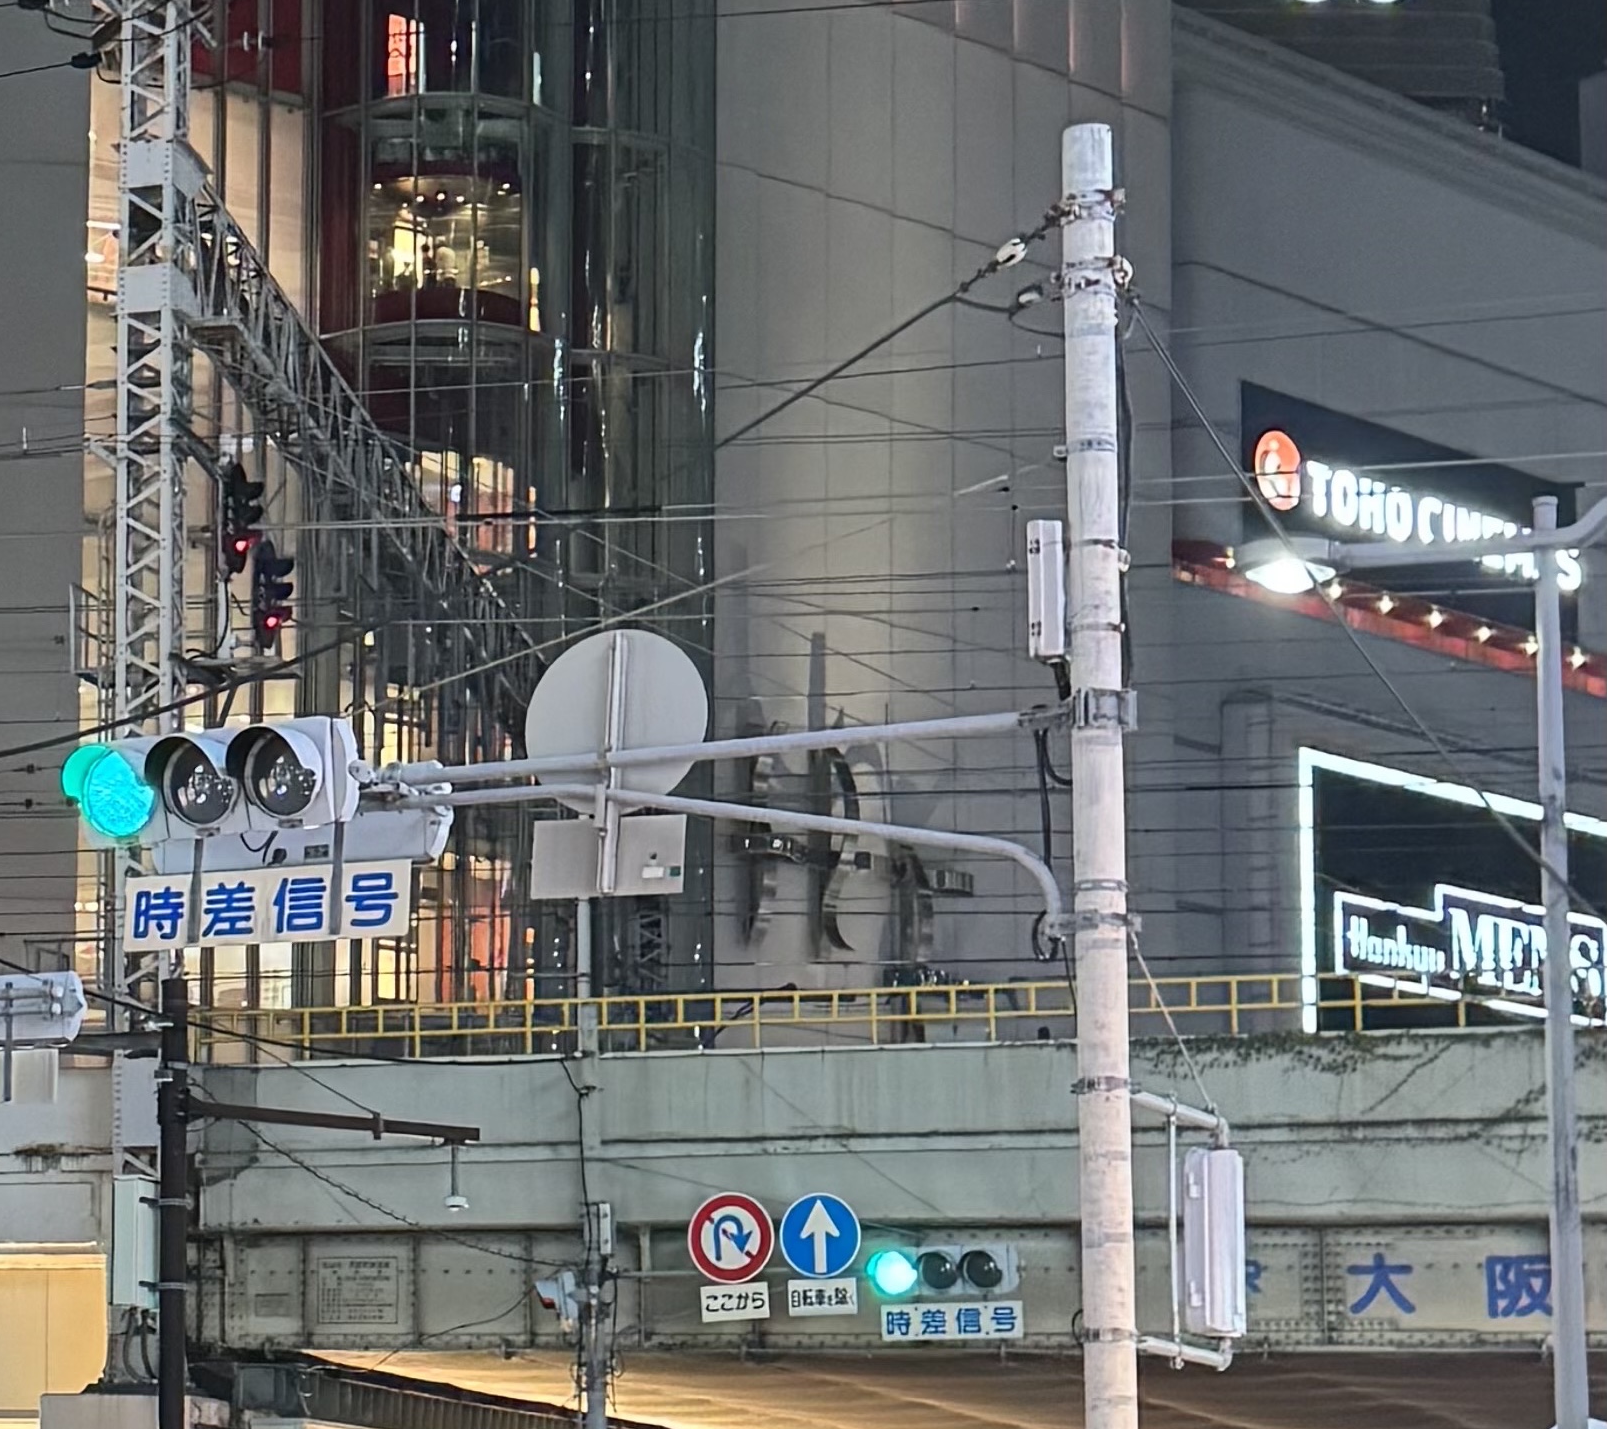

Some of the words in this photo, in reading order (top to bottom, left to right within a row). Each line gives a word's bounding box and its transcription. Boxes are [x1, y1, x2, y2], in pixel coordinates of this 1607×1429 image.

[1305, 460, 1413, 542] TOHO
[1417, 496, 1582, 591] CINEMS
[133, 871, 399, 941] 時差信号
[1347, 914, 1446, 974] Hankyu
[1448, 907, 1600, 997] MENS
[705, 1290, 766, 1312] ここから
[791, 1286, 855, 1308] 自転車を除く
[886, 1306, 1018, 1336] 時差信号
